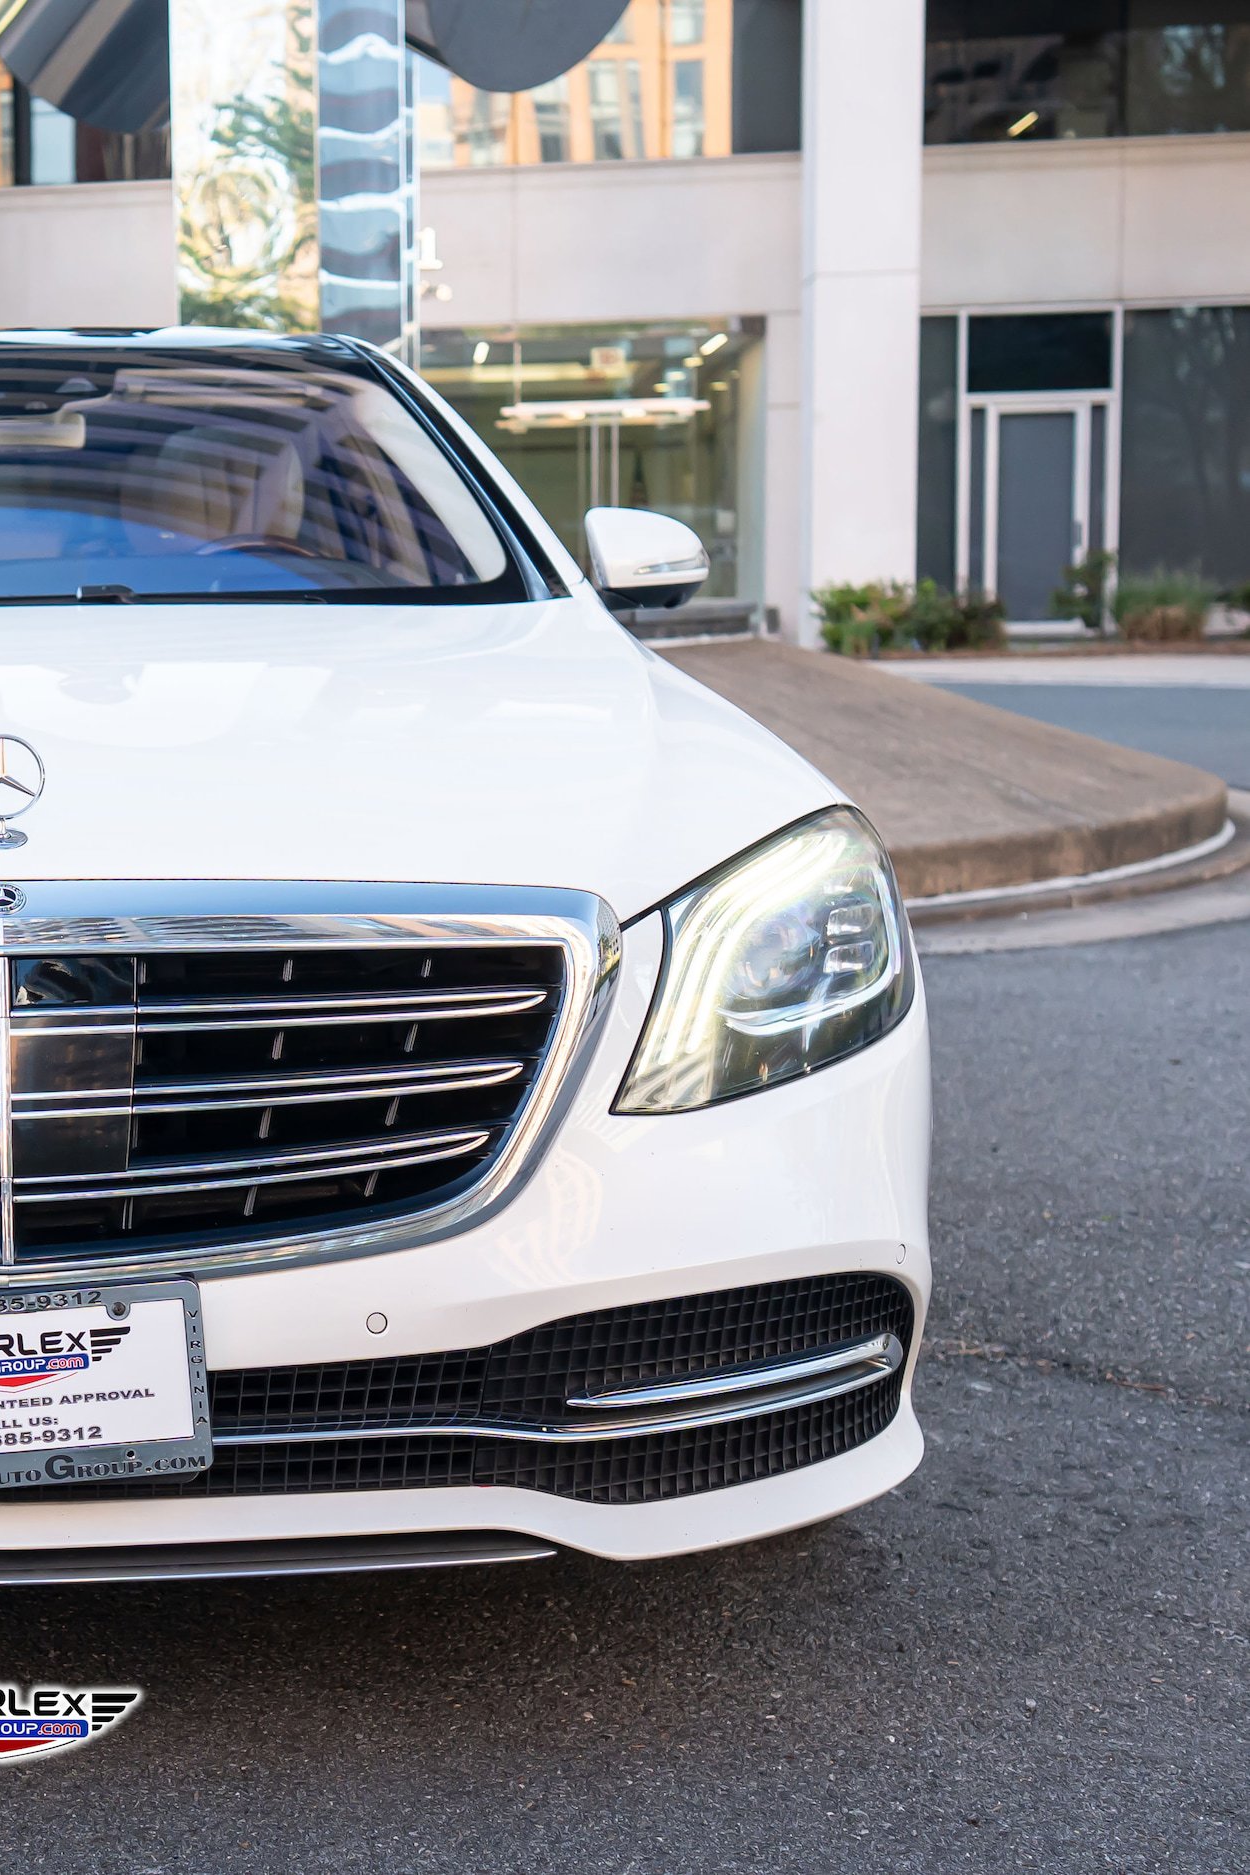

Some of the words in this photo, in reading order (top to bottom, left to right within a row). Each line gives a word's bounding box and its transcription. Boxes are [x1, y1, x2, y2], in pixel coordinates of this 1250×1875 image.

[186, 1310, 208, 1426] VIRGINIA
[59, 1388, 155, 1405] APPROVAL
[29, 1416, 59, 1427] US:
